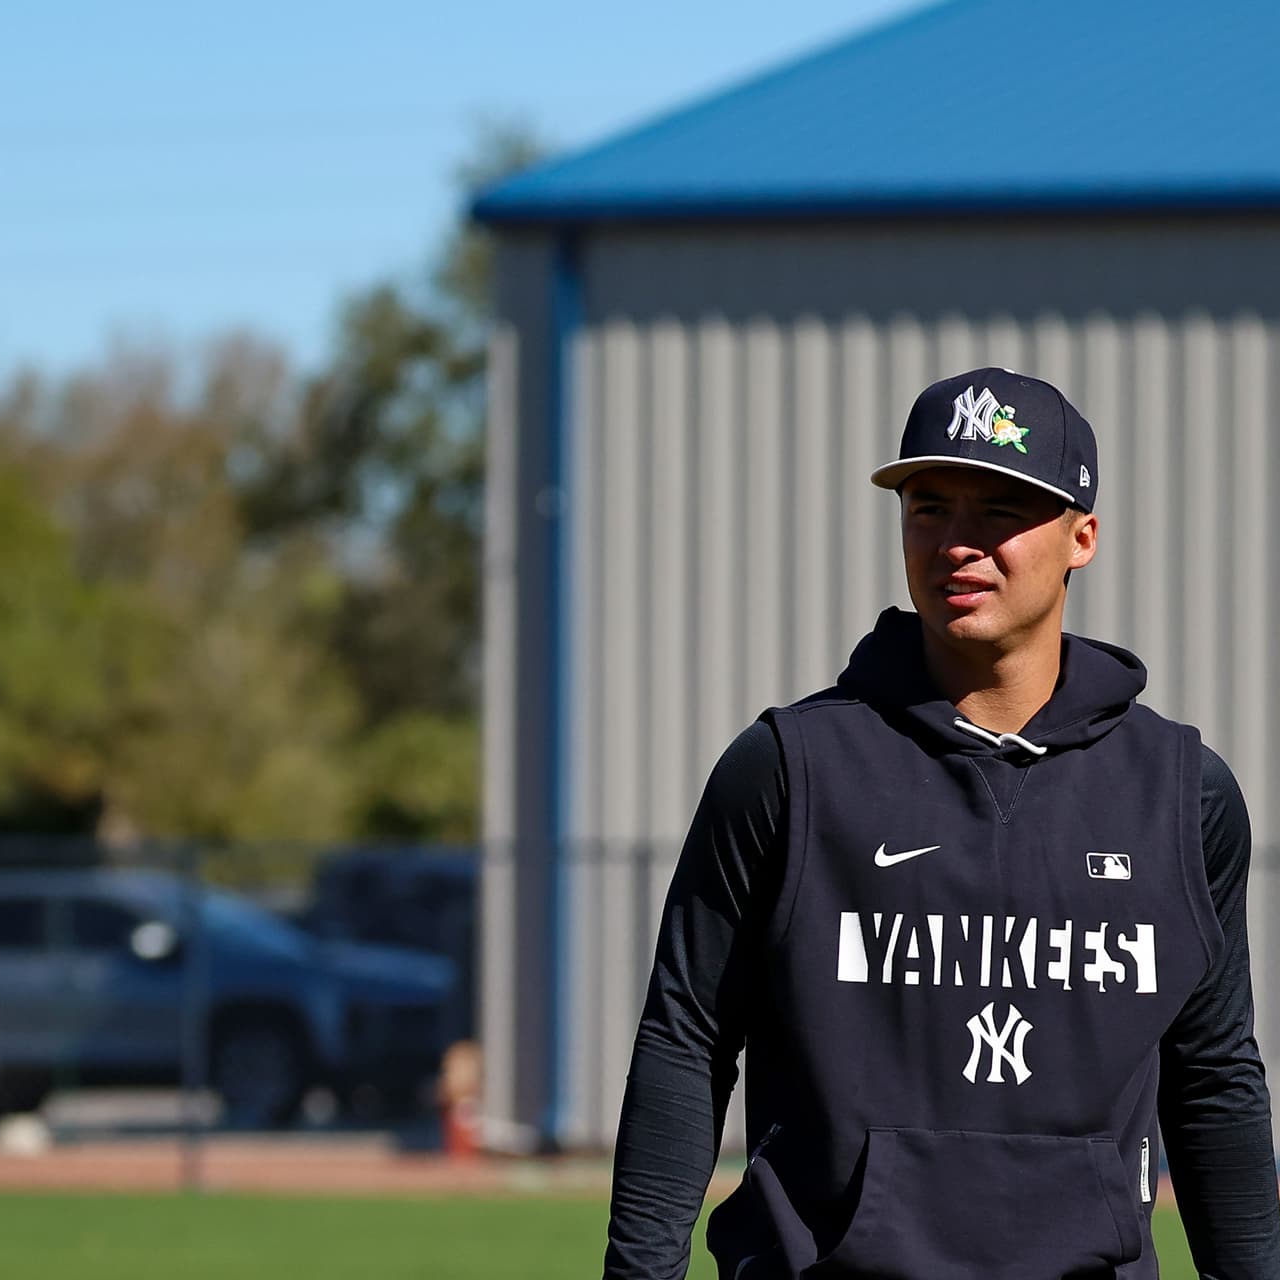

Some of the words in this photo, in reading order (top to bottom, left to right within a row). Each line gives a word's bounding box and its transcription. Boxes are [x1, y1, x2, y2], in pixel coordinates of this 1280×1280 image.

[946, 385, 1002, 441] NY
[837, 911, 1158, 994] YANKEES
[961, 1001, 1035, 1086] NY
